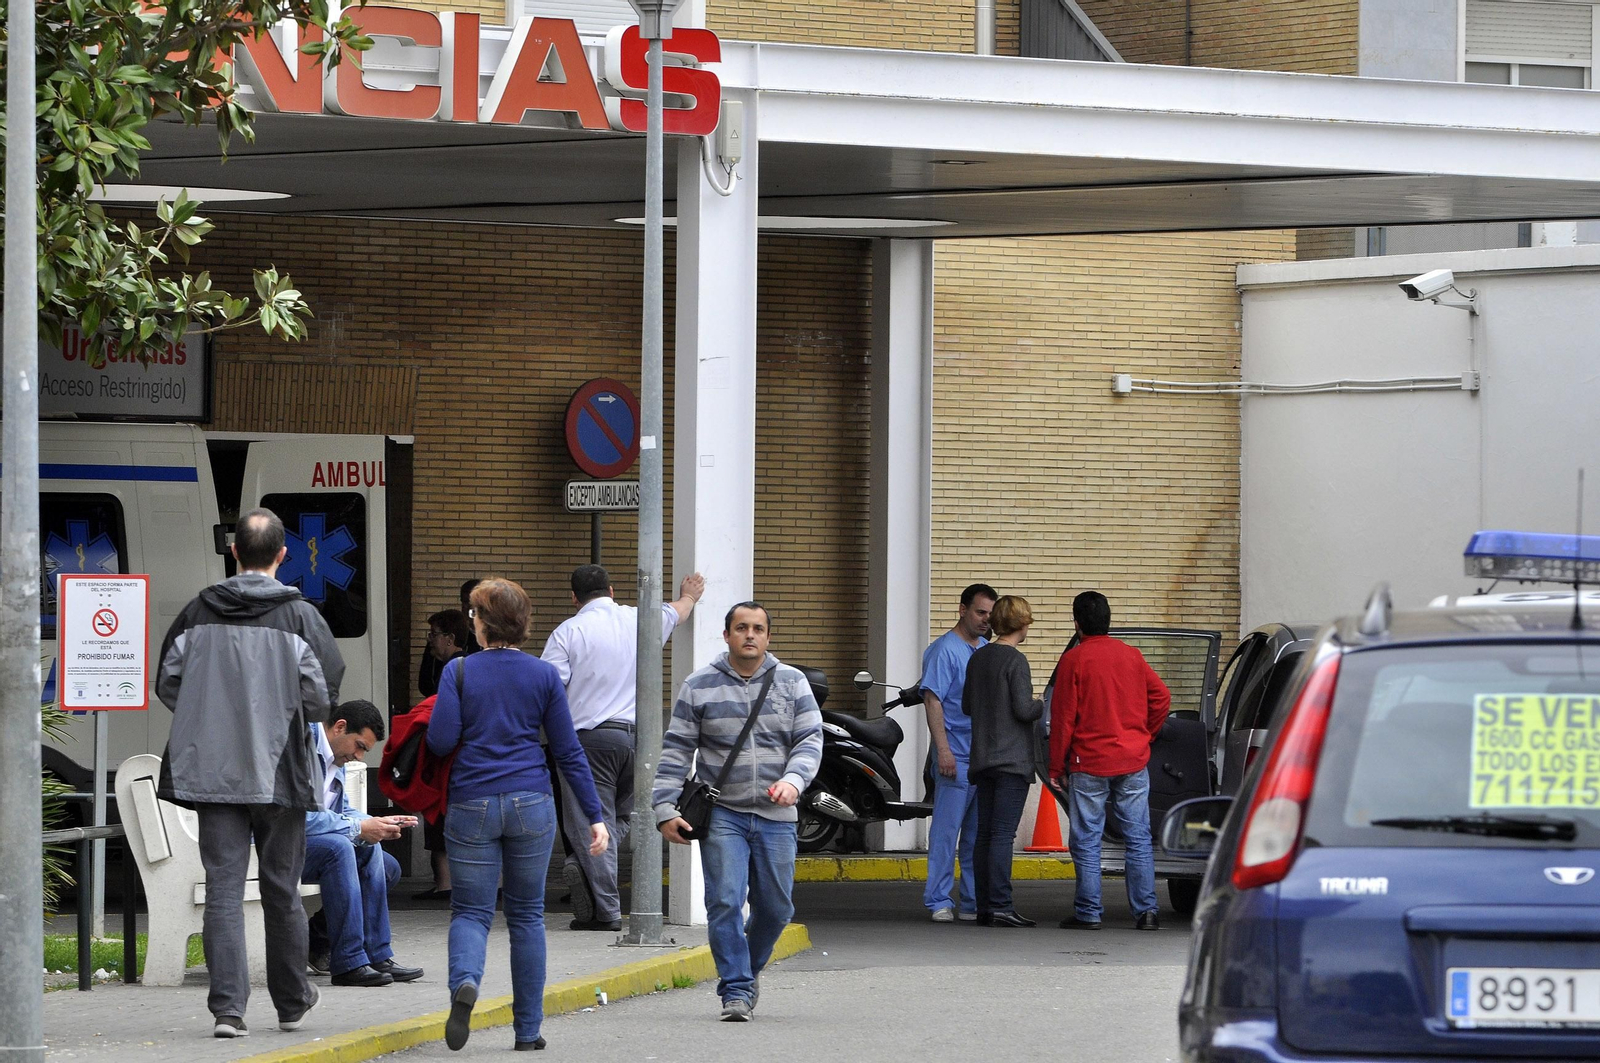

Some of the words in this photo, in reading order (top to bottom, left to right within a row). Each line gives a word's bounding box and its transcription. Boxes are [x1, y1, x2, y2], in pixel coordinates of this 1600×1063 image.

[38, 372, 94, 400] Acceso
[100, 374, 186, 404] Restringido)
[311, 461, 386, 487] AMBUL
[569, 485, 596, 506] EXCEPTO
[598, 485, 639, 506] AMBULANCIAS
[1478, 697, 1524, 726] SE
[1478, 729, 1523, 748] 1600
[1530, 730, 1555, 749] CC
[1476, 751, 1532, 771] TODO
[1540, 754, 1576, 773] LOS
[1319, 877, 1388, 895] TACUMA
[1479, 977, 1575, 1012] 8931
